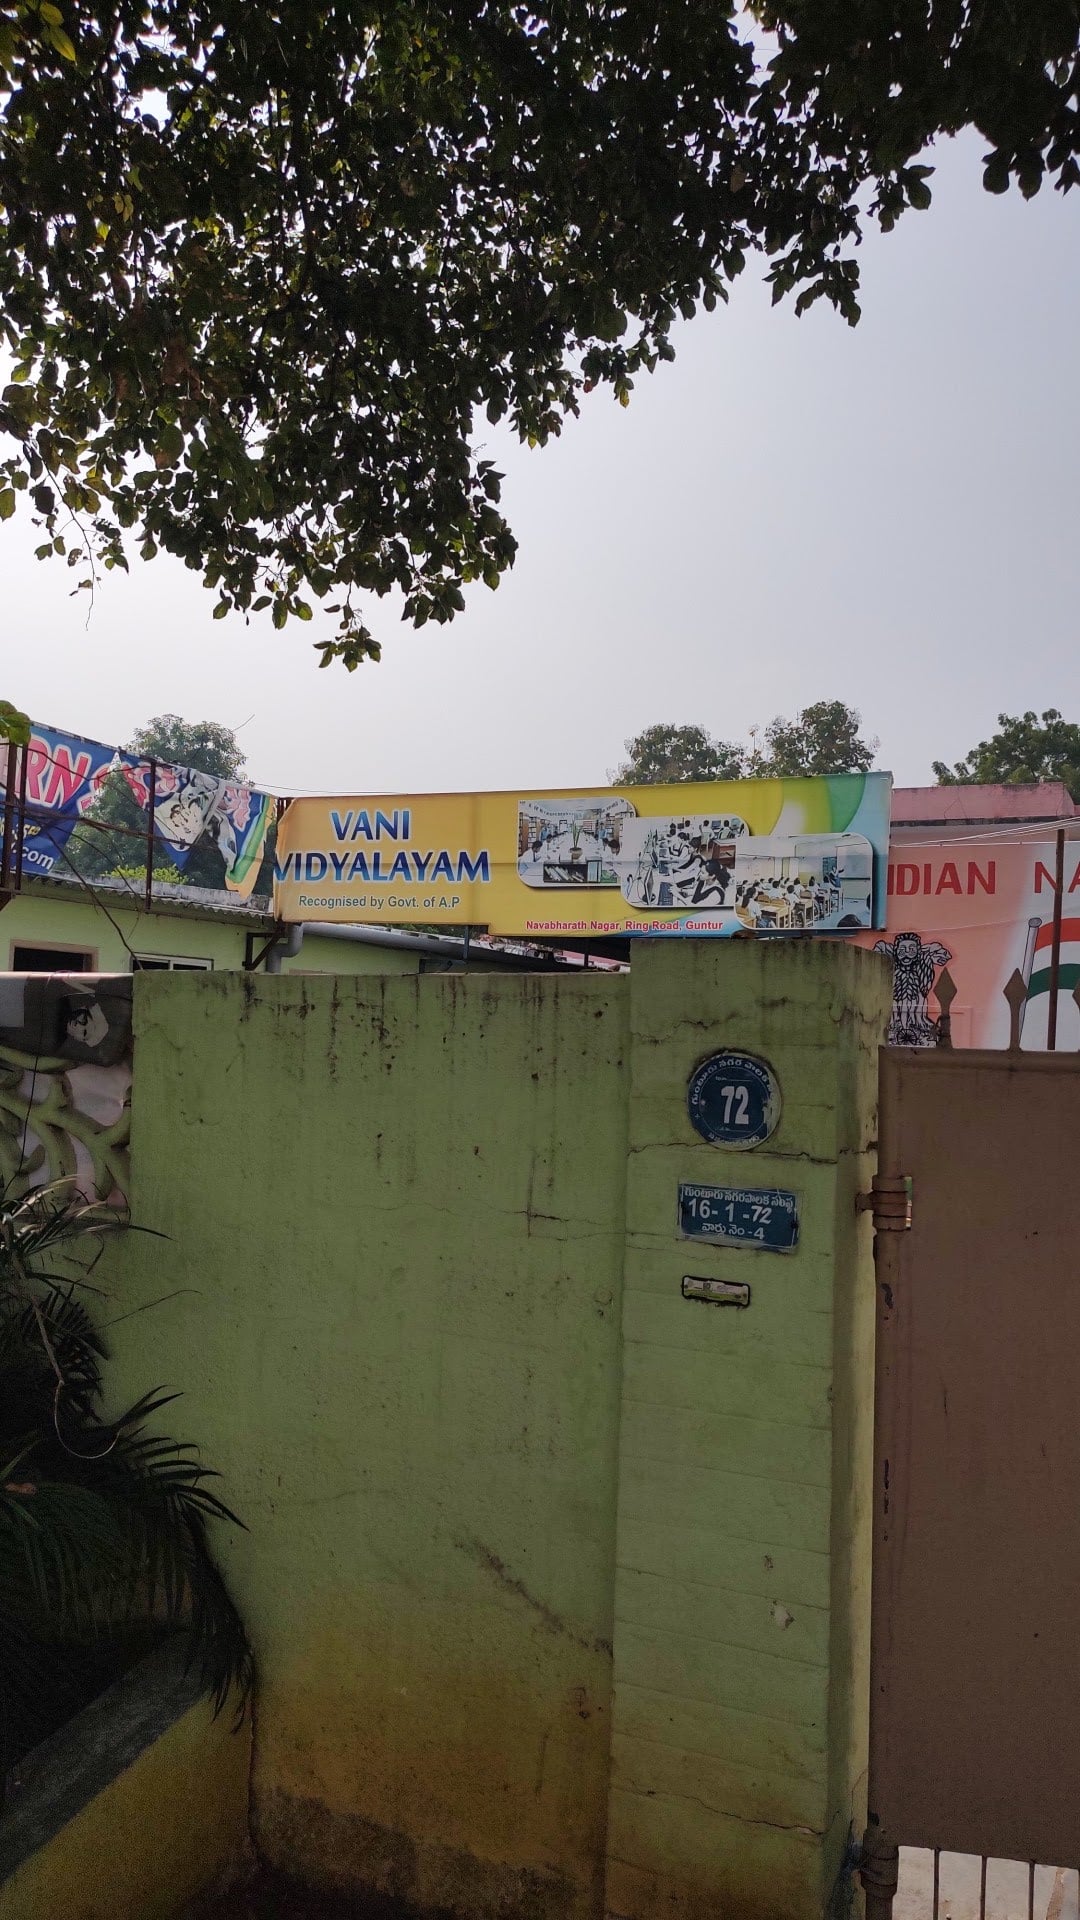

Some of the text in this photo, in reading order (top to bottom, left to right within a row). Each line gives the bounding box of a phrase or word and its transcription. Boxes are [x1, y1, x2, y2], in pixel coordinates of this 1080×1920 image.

[330, 809, 411, 842] VANI
[274, 850, 491, 883] VIDYALAYAM
[299, 895, 461, 910] Recognised by Govt. of A.P
[526, 920, 724, 932] Navabharath Nagar, Ring Road, Guntur
[720, 1085, 750, 1125] 72
[684, 1186, 724, 1200] గుంటూరు
